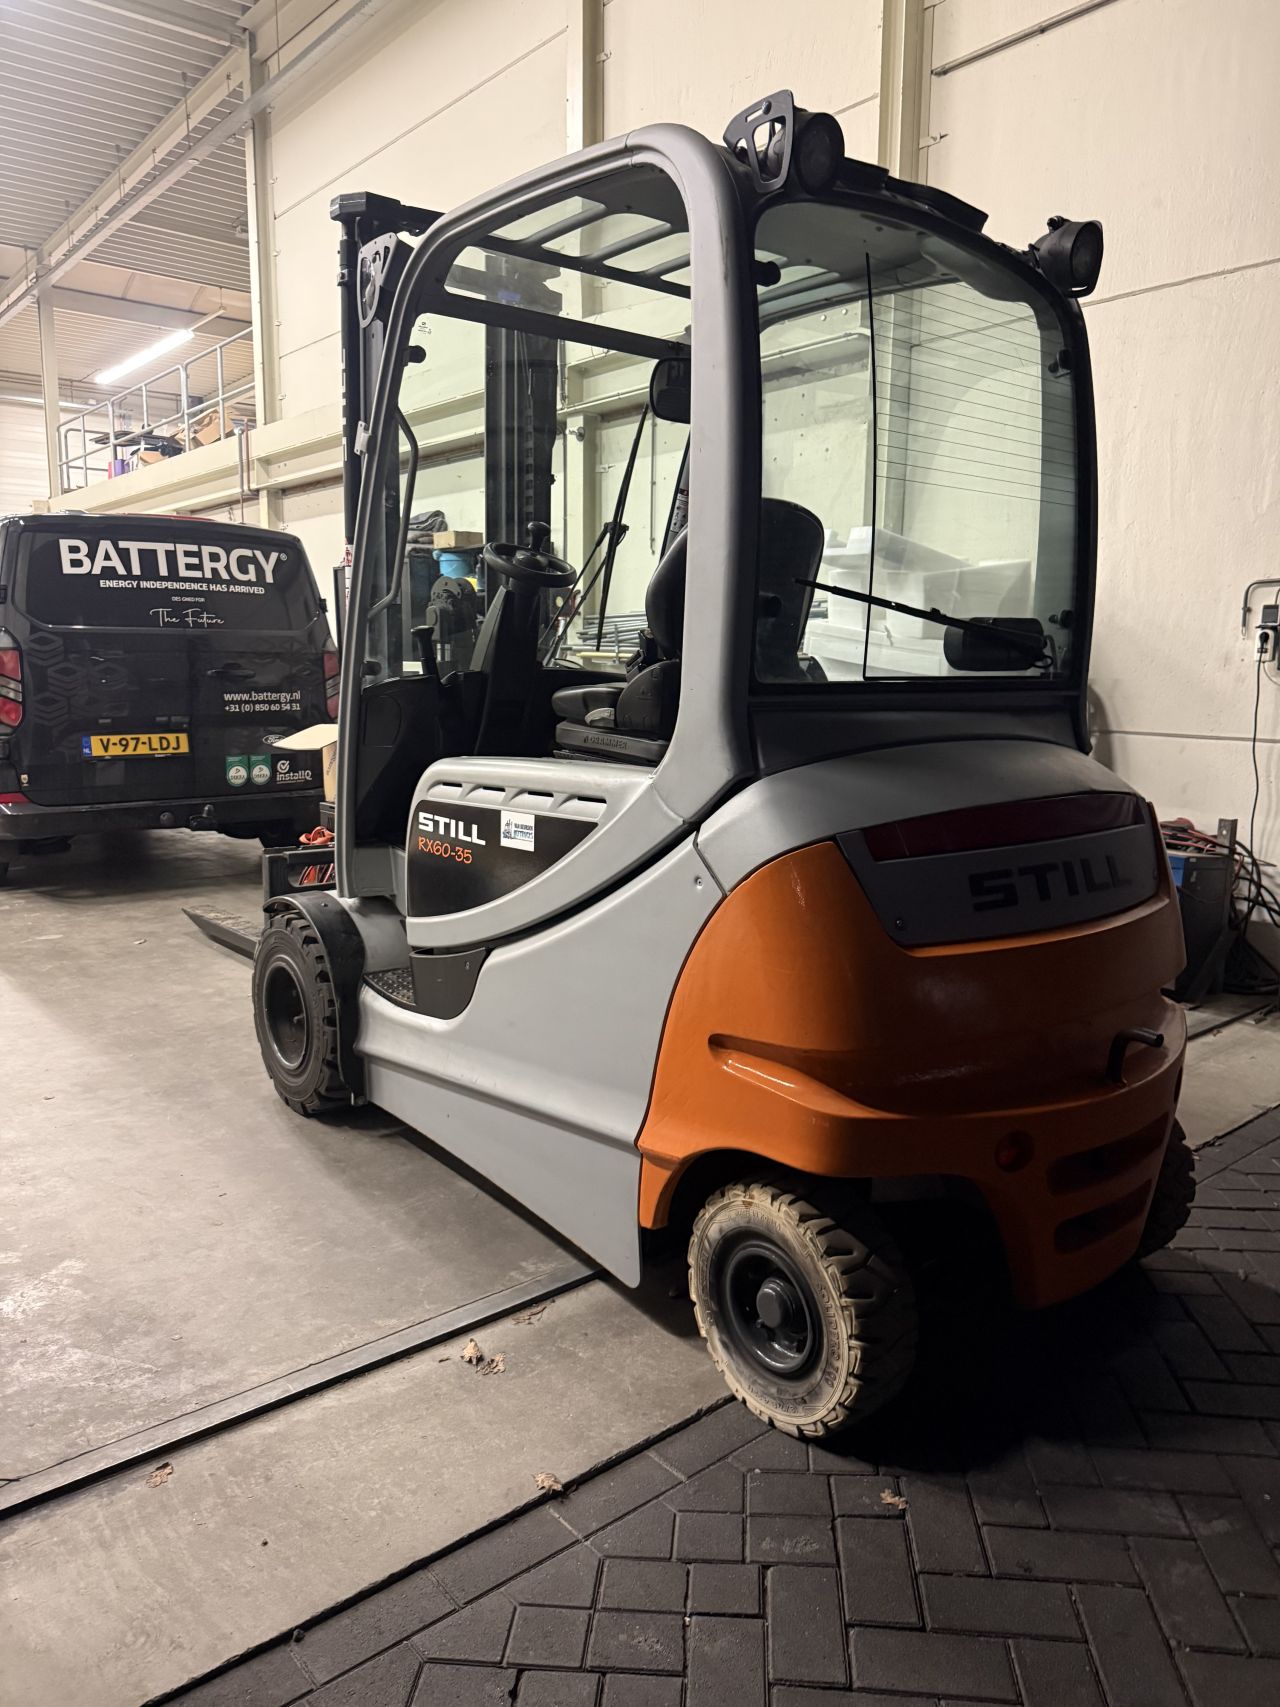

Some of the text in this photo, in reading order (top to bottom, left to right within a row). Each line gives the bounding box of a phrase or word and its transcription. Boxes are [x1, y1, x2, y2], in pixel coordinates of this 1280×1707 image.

[100, 580, 265, 594] ENERGY INDEPENDENCE HAS ARRIVED
[149, 608, 225, 628] The Future
[223, 690, 301, 703] www.battergy.nl
[224, 702, 301, 713] +31 (0) 850 60 54 31
[99, 736, 181, 753] V-97-LDJ
[418, 811, 487, 846] STILL
[417, 836, 473, 864] RX60-35
[967, 854, 1134, 912] STILL
